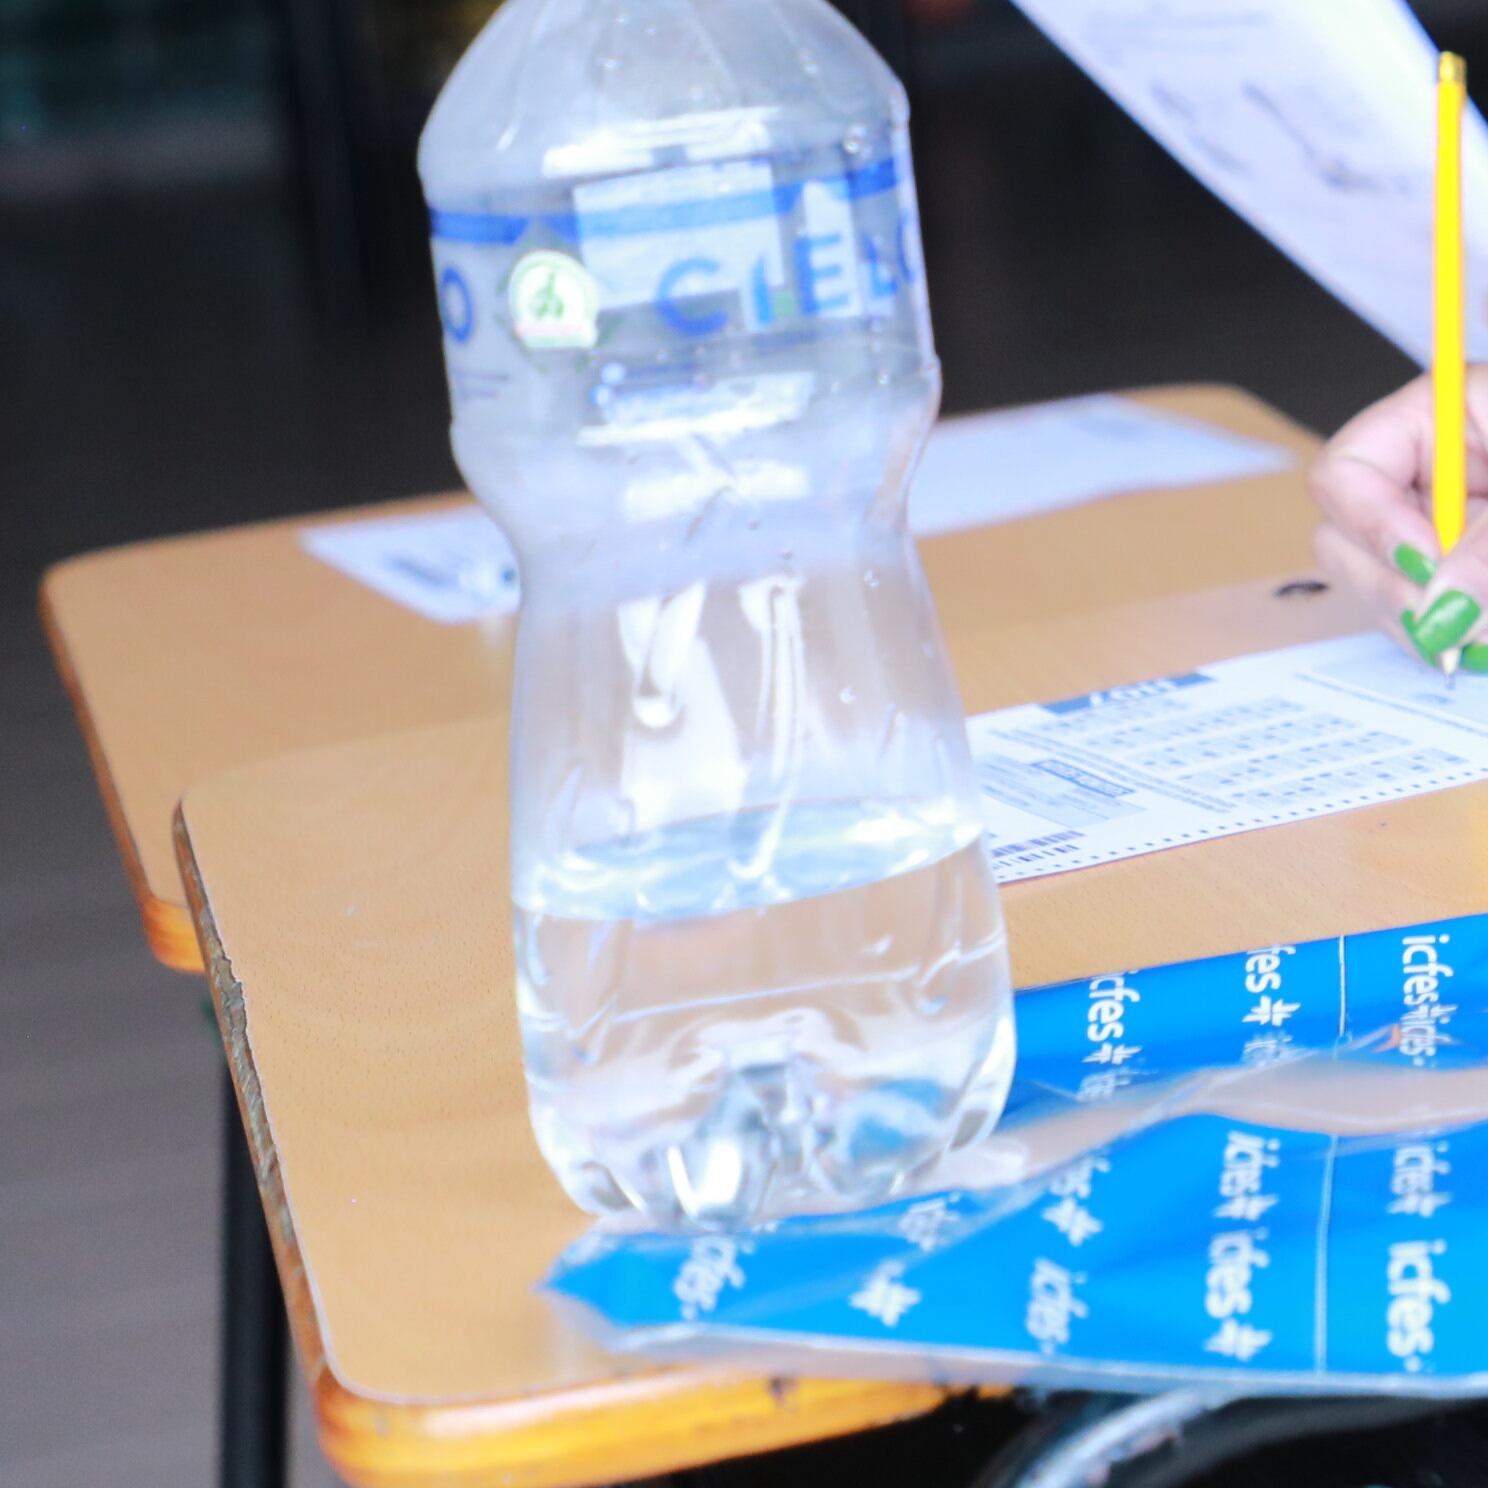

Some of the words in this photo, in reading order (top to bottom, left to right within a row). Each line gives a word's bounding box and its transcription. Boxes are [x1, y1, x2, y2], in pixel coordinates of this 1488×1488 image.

[1402, 934, 1454, 1006] icfes
[1219, 1129, 1281, 1198] icfes
[1391, 1140, 1451, 1195] icfes
[1025, 1258, 1089, 1346] icfes
[1204, 1225, 1271, 1319] icfes
[1386, 1237, 1451, 1358] icfes
